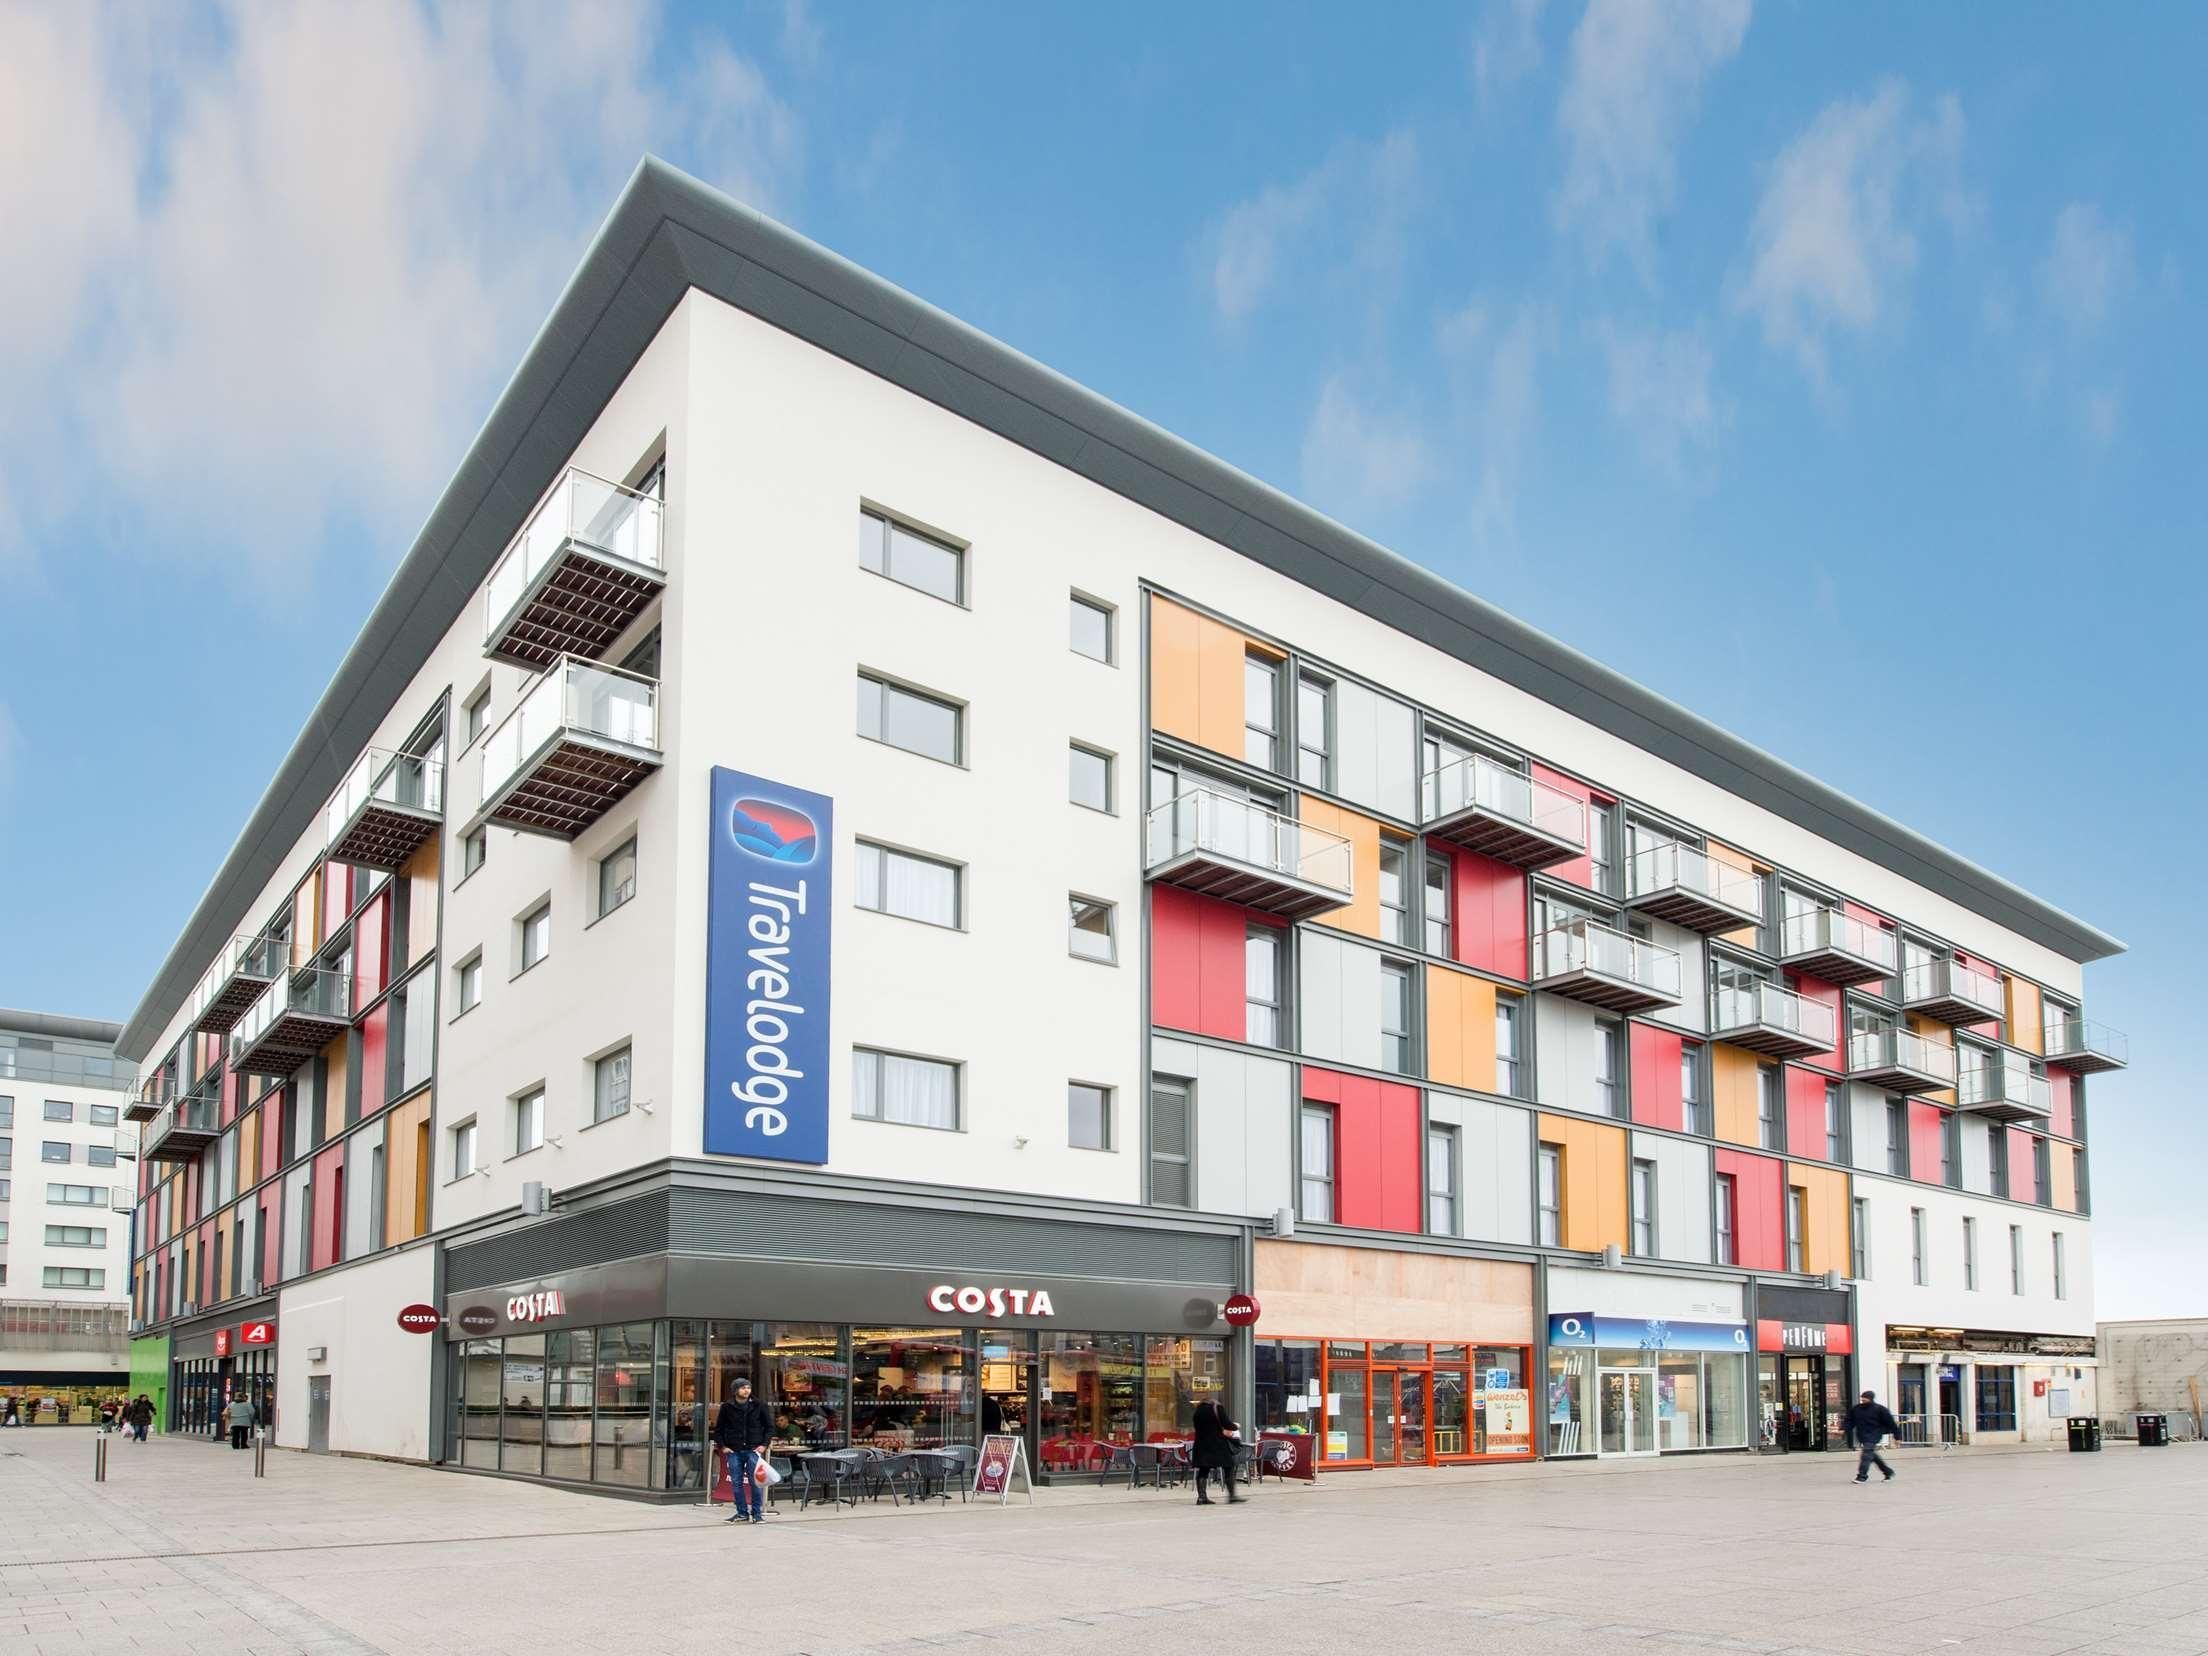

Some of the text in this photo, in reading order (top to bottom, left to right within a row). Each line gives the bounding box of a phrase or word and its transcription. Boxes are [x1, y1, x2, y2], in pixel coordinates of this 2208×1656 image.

[731, 879, 807, 1137] Travelodge
[507, 1291, 563, 1322] COSTA
[929, 1285, 1056, 1318] COSTA
[1226, 1306, 1252, 1314] COSTA
[402, 1315, 438, 1324] COSTA
[1561, 1318, 1586, 1338] O2
[1782, 1326, 1827, 1348] PERFUME
